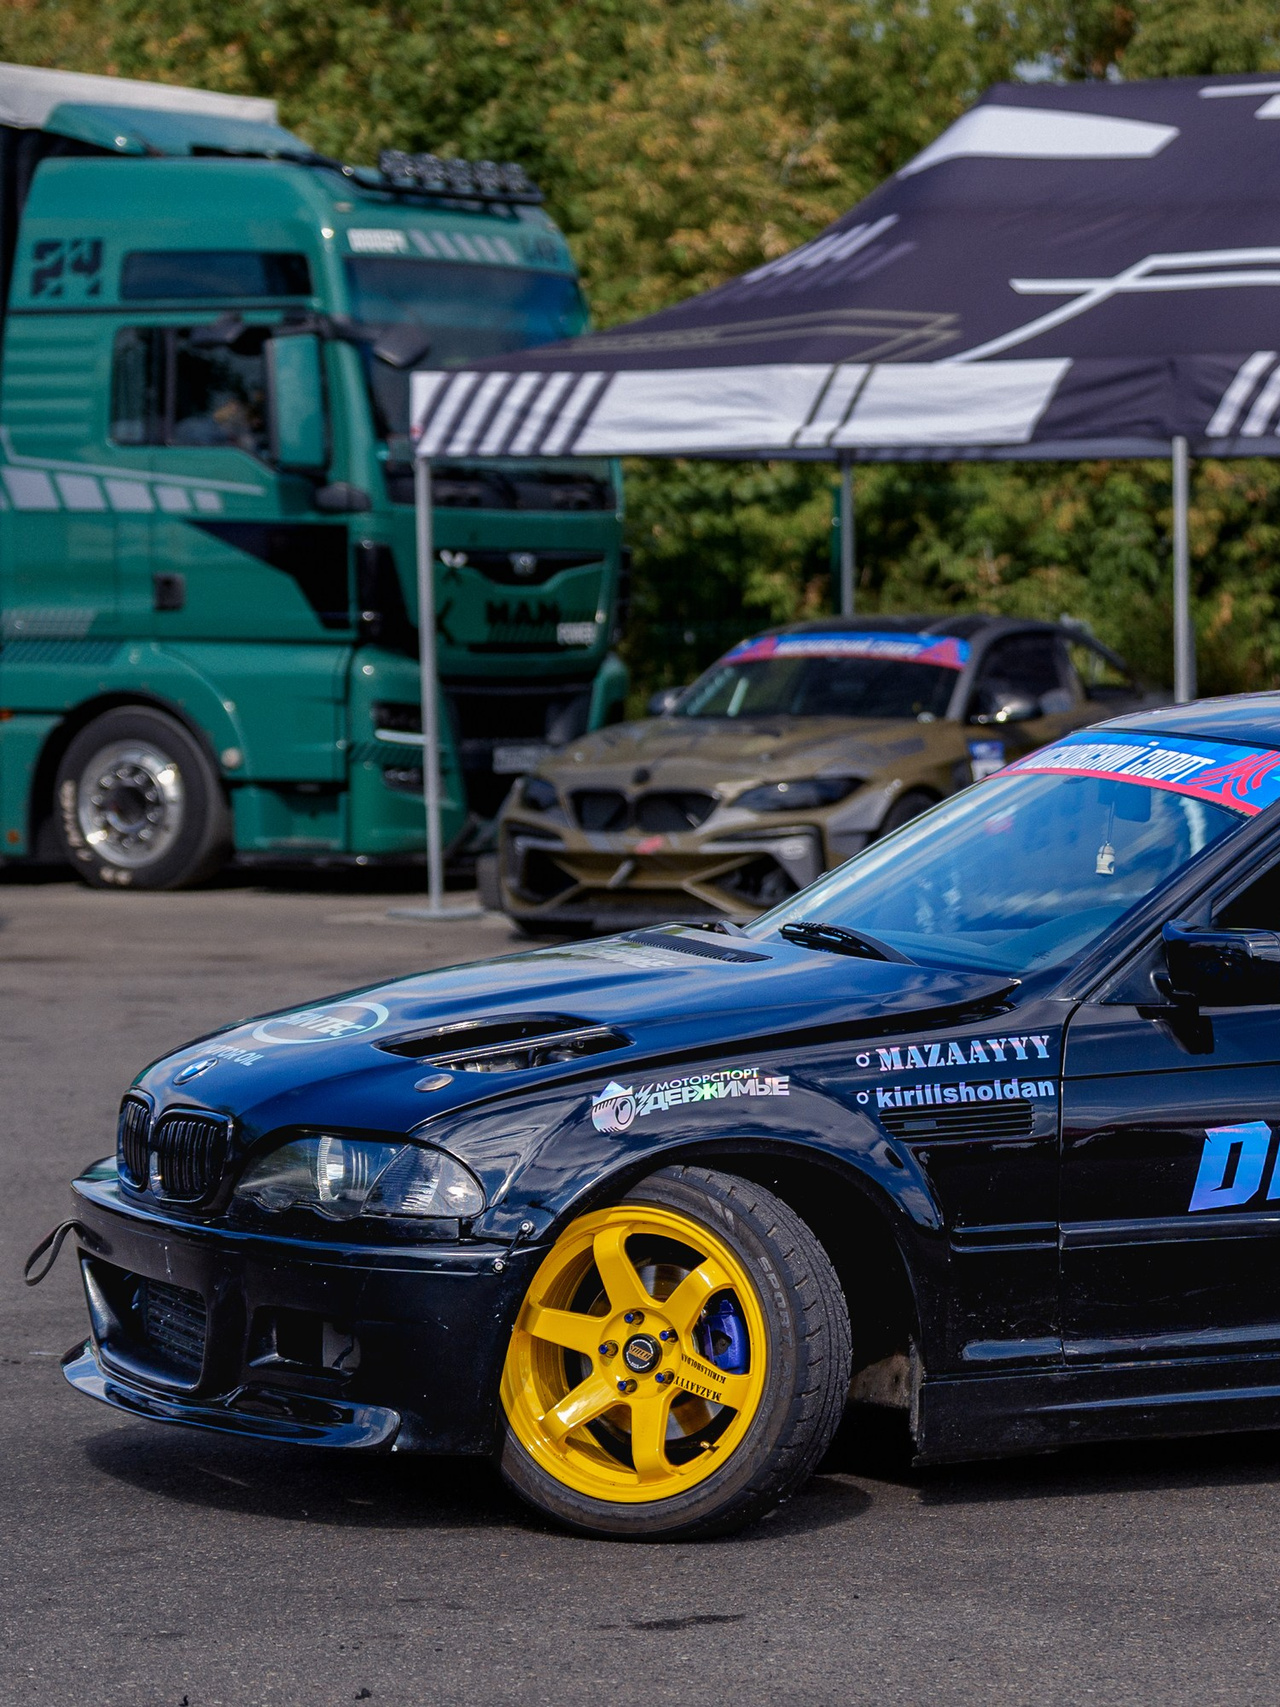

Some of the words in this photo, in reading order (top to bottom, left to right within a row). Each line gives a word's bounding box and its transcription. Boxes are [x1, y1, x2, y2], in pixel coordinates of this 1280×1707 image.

[486, 602, 560, 626] MAN
[1118, 748, 1217, 783] СПОРТ
[233, 1052, 265, 1067] OIL
[876, 1035, 1050, 1071] MAZAAYYY
[656, 1067, 759, 1092] МОТОРСПОРТ
[876, 1078, 1055, 1108] kirillsholdan
